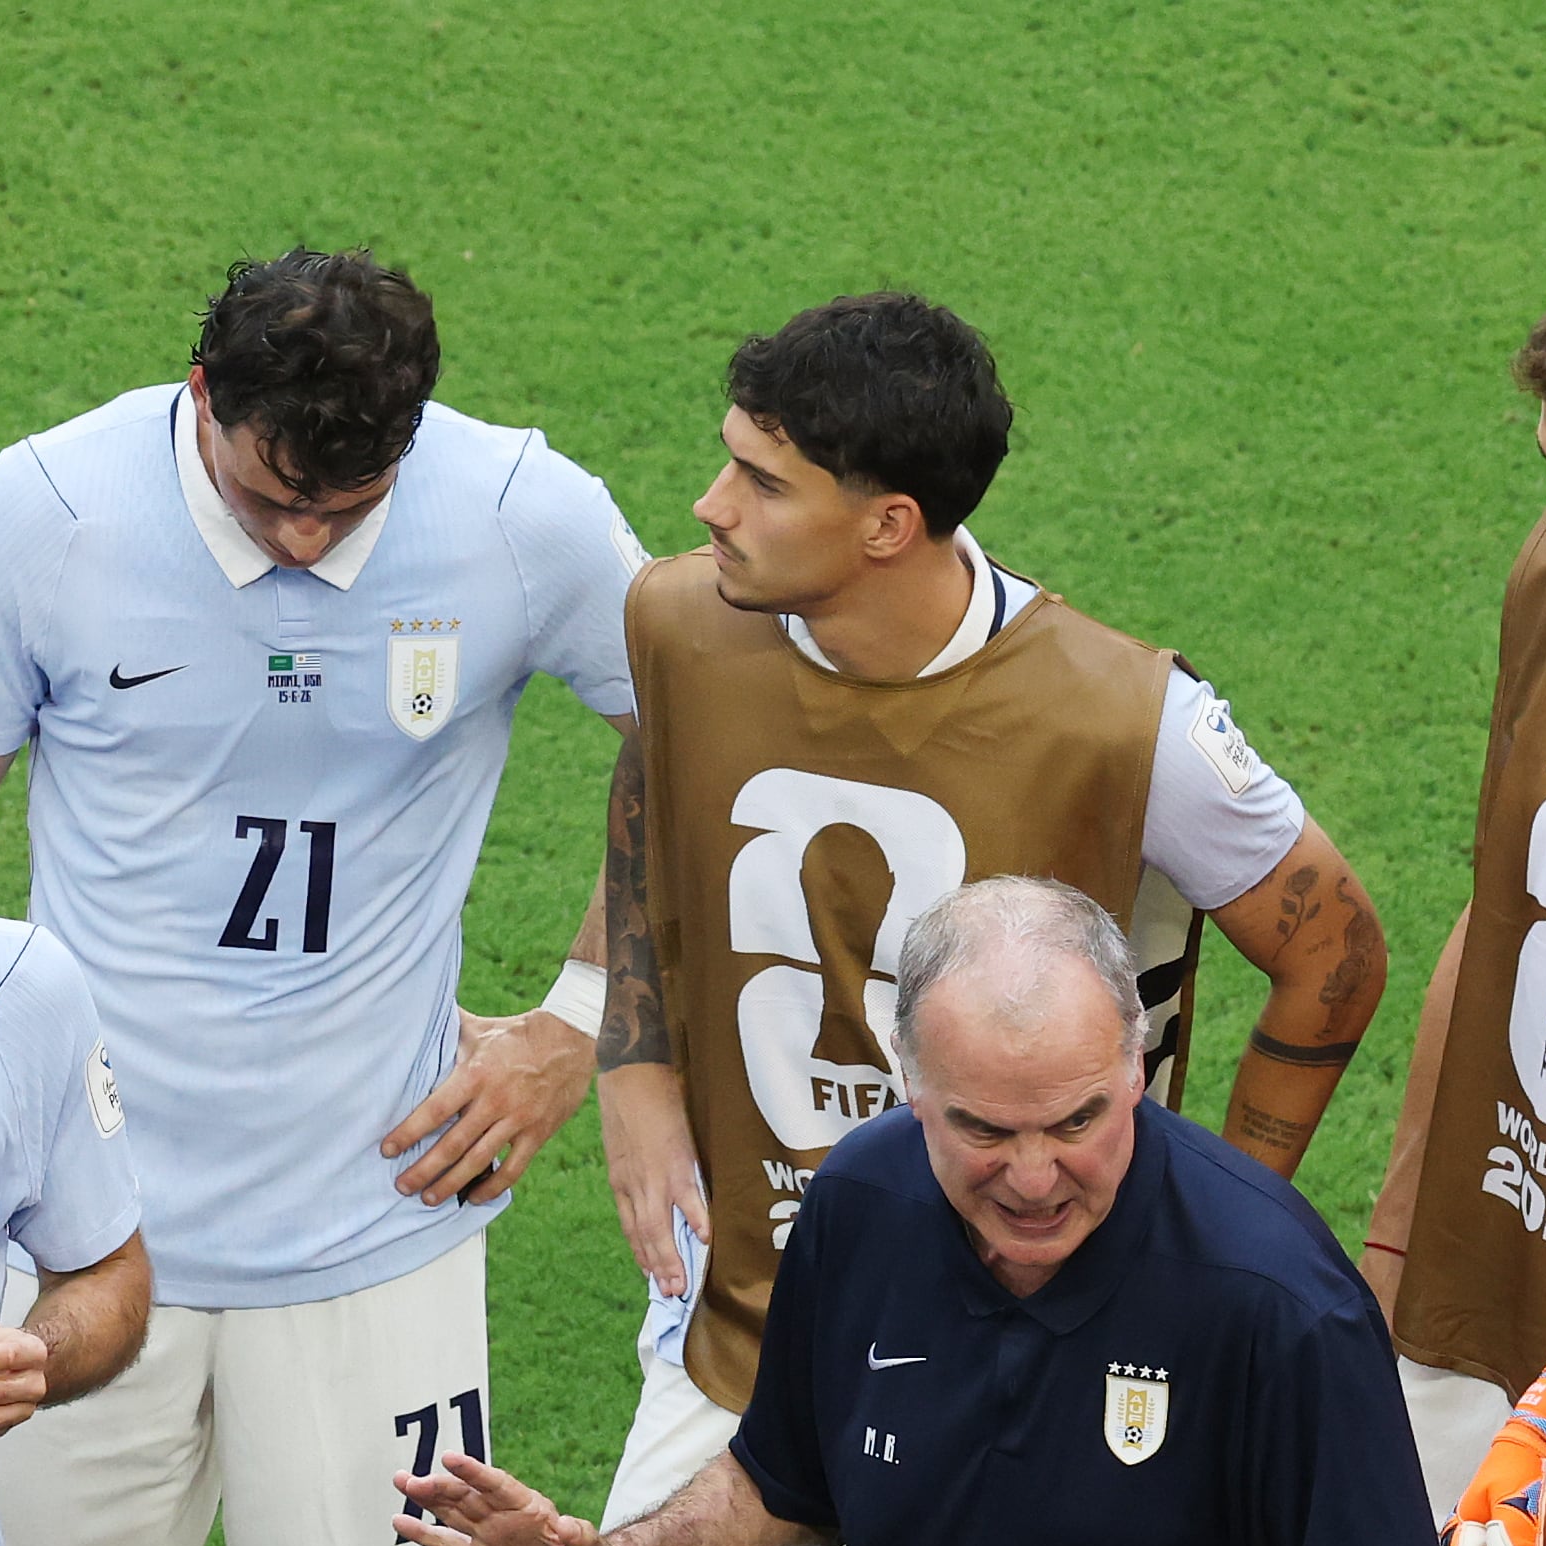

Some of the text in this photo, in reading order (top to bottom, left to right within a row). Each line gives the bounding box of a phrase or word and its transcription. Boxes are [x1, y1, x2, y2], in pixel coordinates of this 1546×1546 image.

[268, 674, 321, 688] MIAMI, USA
[218, 816, 337, 953] 21
